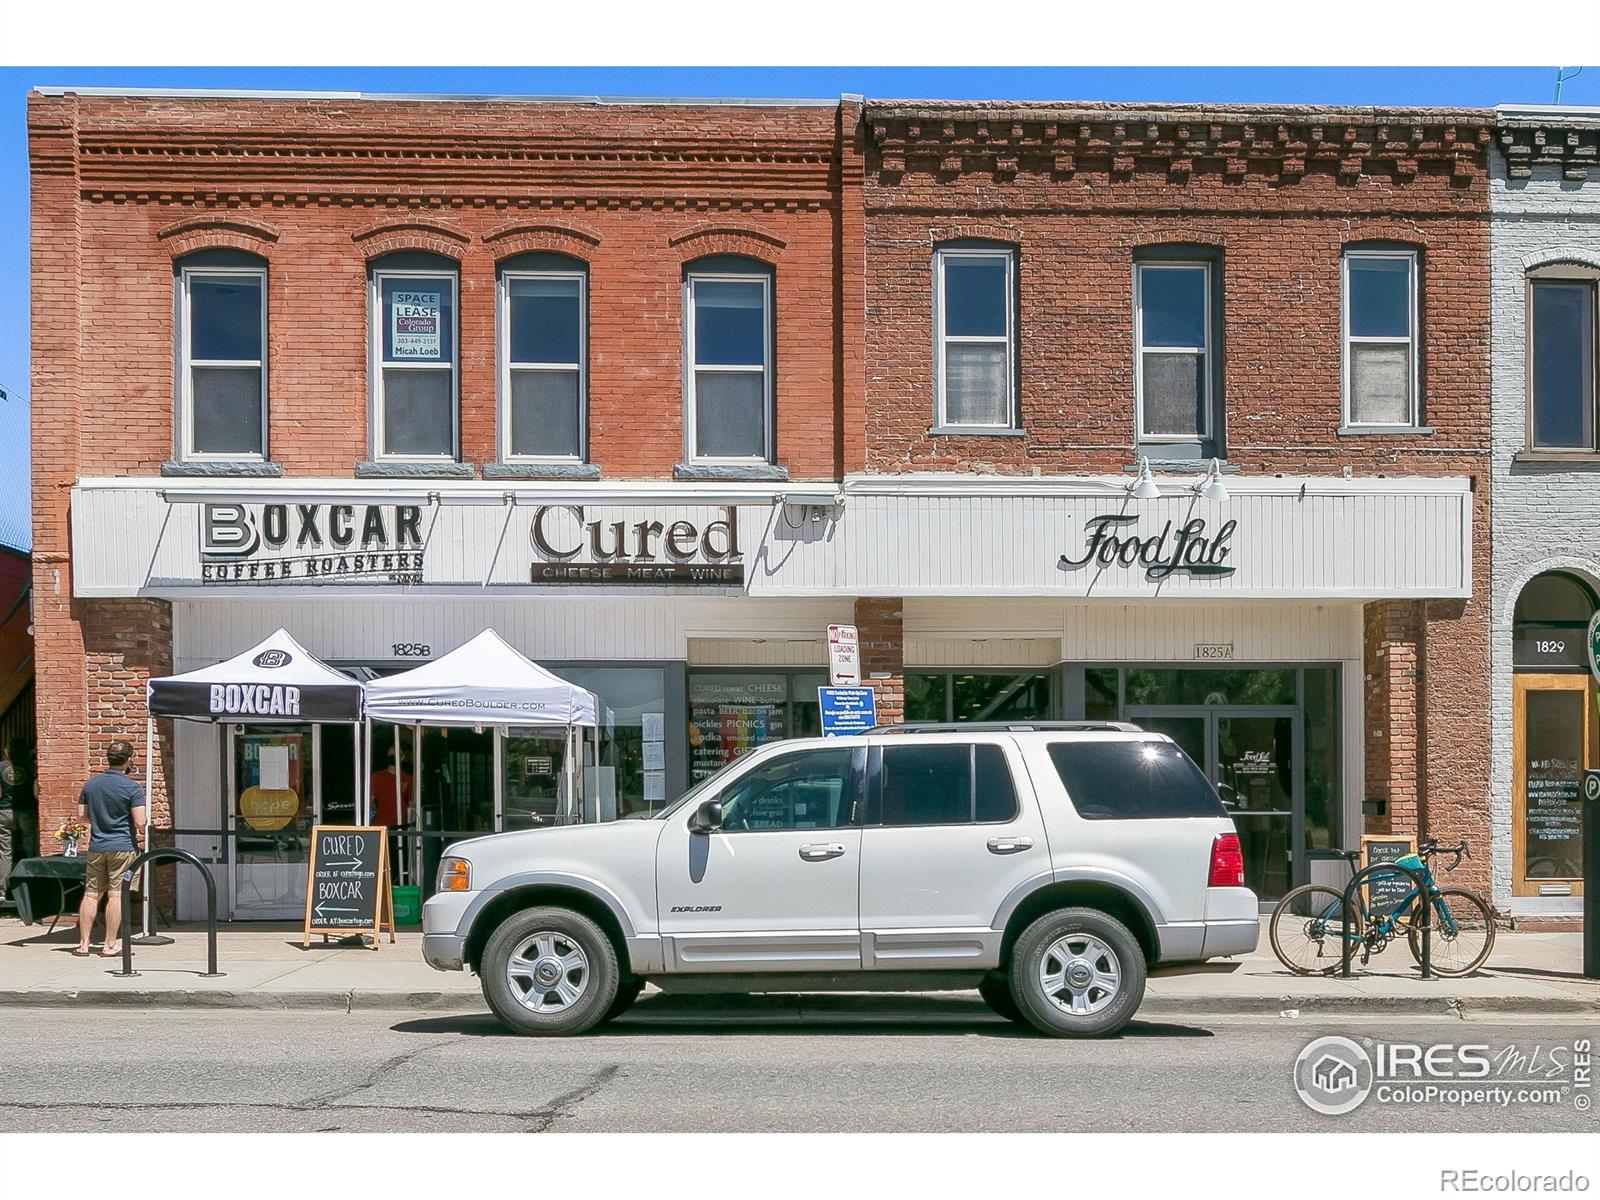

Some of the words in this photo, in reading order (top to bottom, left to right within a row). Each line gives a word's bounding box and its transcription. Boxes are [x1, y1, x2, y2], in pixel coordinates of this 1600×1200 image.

[397, 294, 436, 303] SPACE
[396, 307, 437, 317] LEASE
[398, 318, 432, 326] Colorado
[408, 325, 434, 333] Group
[395, 347, 418, 355] Micah
[420, 347, 439, 355] Loeb
[200, 504, 422, 556] BOXCAR
[531, 505, 745, 559] Cured
[1057, 514, 1173, 570] Food
[1145, 518, 1237, 581] Lab
[202, 561, 292, 580] COFFEE
[306, 553, 423, 577] ROASTERS
[542, 567, 613, 578] CHEESE
[627, 567, 675, 579] MEAT
[690, 568, 734, 580] WINE
[392, 643, 431, 656] 1825B
[834, 645, 855, 653] LOADING
[1536, 641, 1565, 653] 1829
[1195, 647, 1232, 658] 1825A
[747, 684, 783, 692] CHEESE
[210, 684, 300, 716] BOXCAR
[734, 696, 757, 704] WINE
[693, 708, 715, 716] pasta
[743, 707, 767, 715] bacon
[768, 708, 784, 717] jam
[693, 720, 722, 728] pickles
[727, 720, 765, 728] PICNICS
[770, 722, 783, 730] gin
[693, 732, 722, 741] vodka
[693, 748, 729, 758] catering
[693, 759, 727, 767] mustard
[753, 820, 783, 828] BREAD
[323, 836, 365, 856] CURED
[316, 870, 331, 878] ORDER
[320, 881, 363, 900] BOXCAR
[312, 918, 328, 926] ORDER
